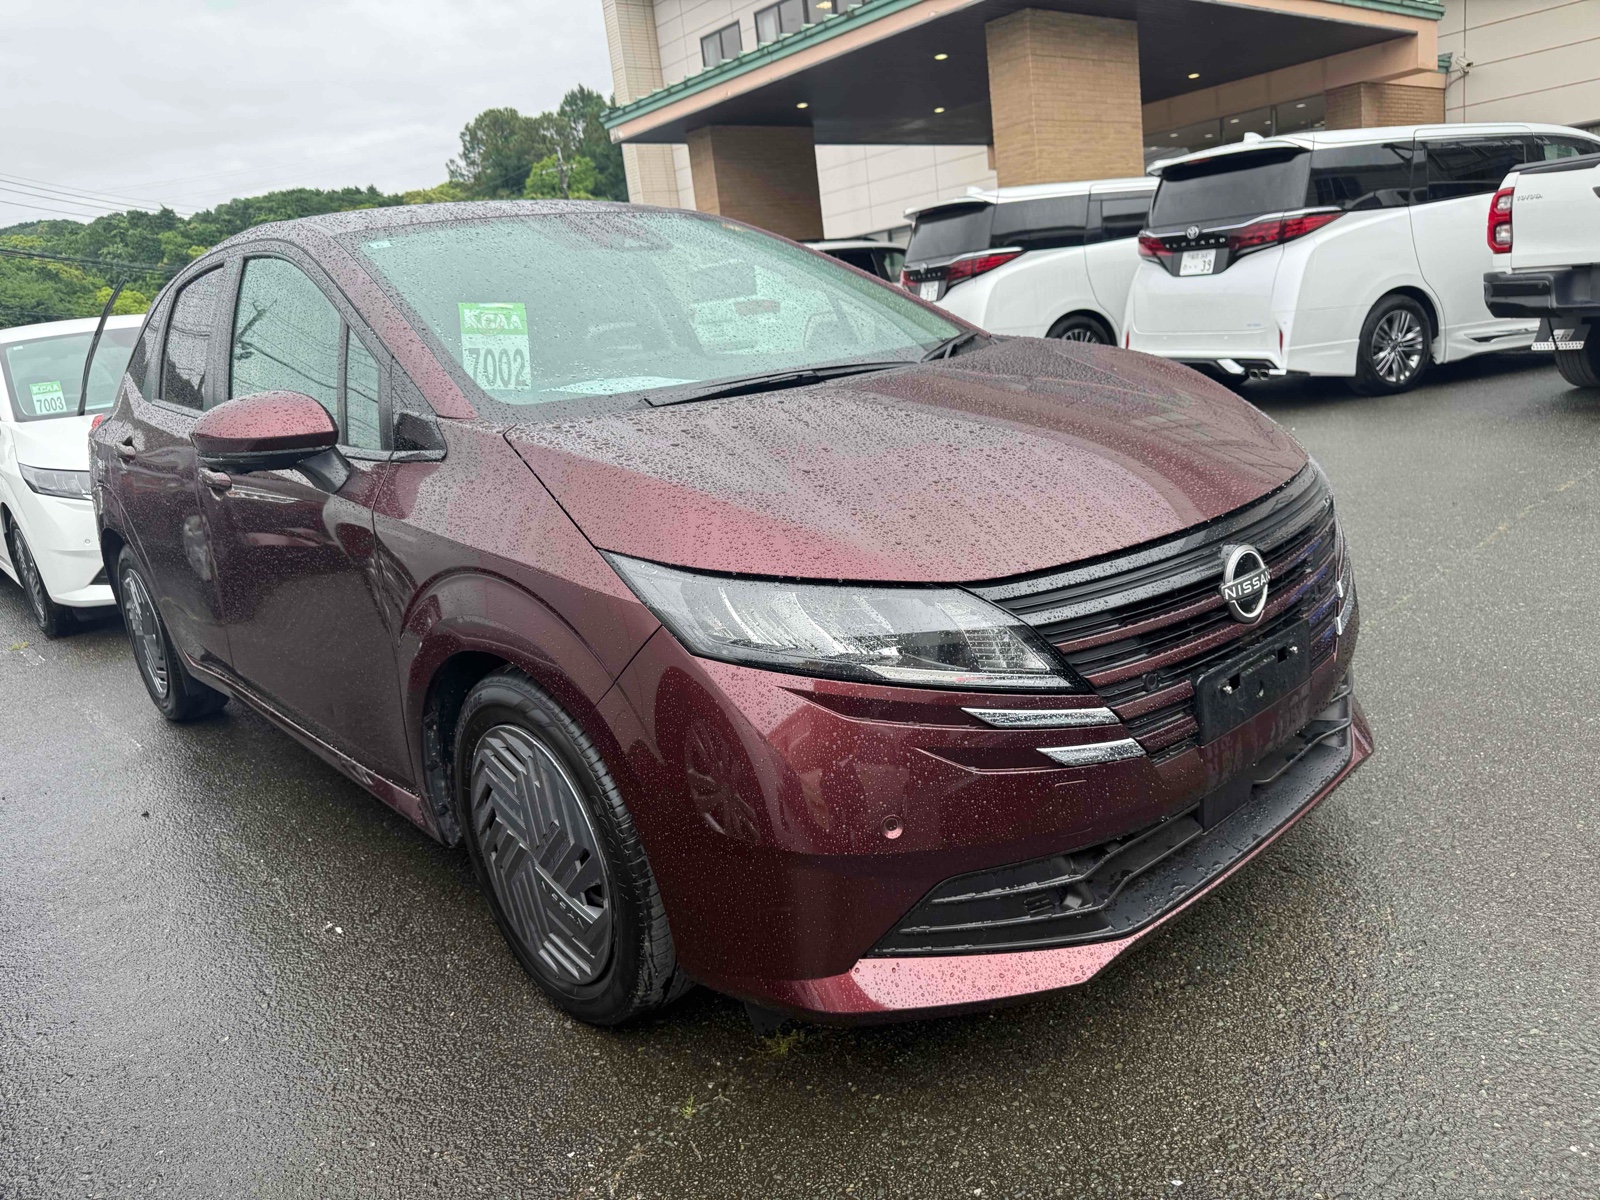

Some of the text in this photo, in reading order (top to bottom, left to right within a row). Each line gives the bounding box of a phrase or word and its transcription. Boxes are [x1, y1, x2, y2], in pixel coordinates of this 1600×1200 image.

[1516, 193, 1543, 202] TOYOTA
[467, 347, 527, 388] 7002
[36, 397, 64, 413] 7003
[1224, 570, 1271, 600] NISSAN
